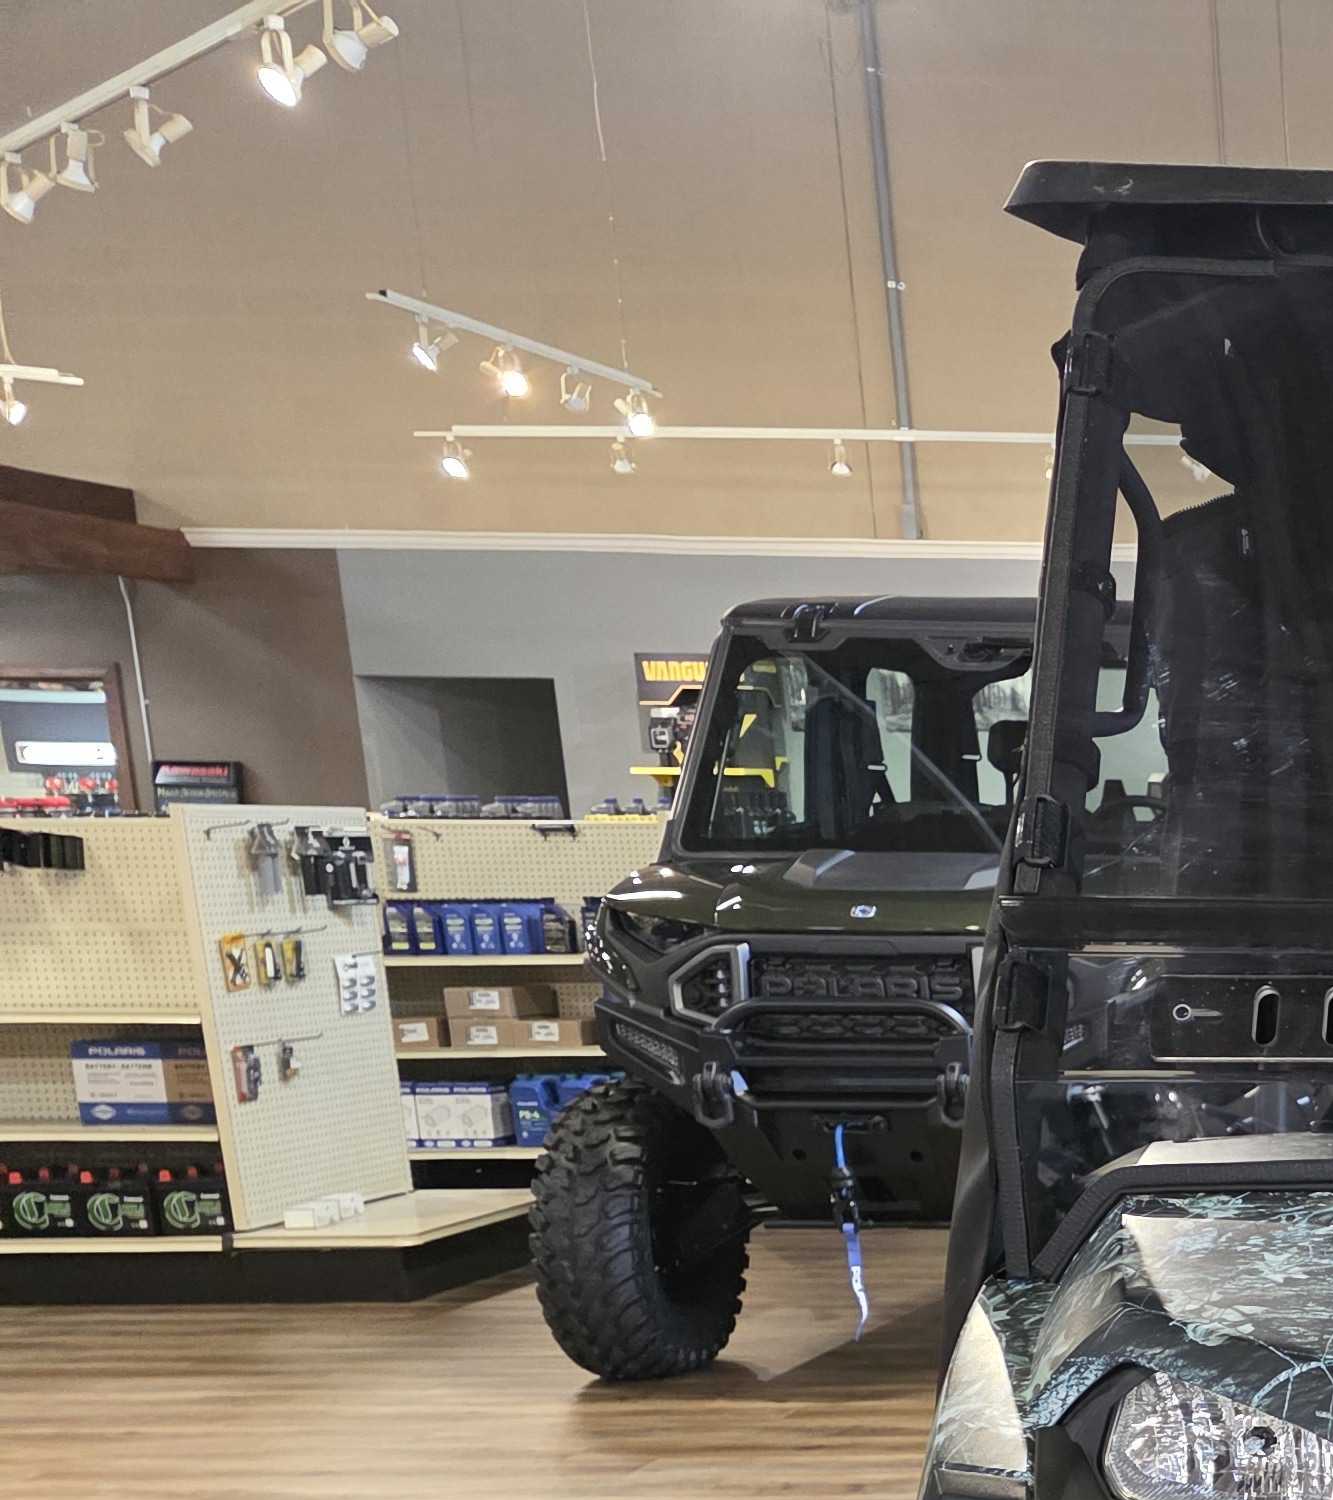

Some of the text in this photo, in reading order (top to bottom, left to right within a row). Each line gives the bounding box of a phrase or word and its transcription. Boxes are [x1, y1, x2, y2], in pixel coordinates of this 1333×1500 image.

[641, 660, 708, 682] VANGU
[760, 973, 963, 999] POLARIS
[88, 1046, 147, 1057] POLARIS
